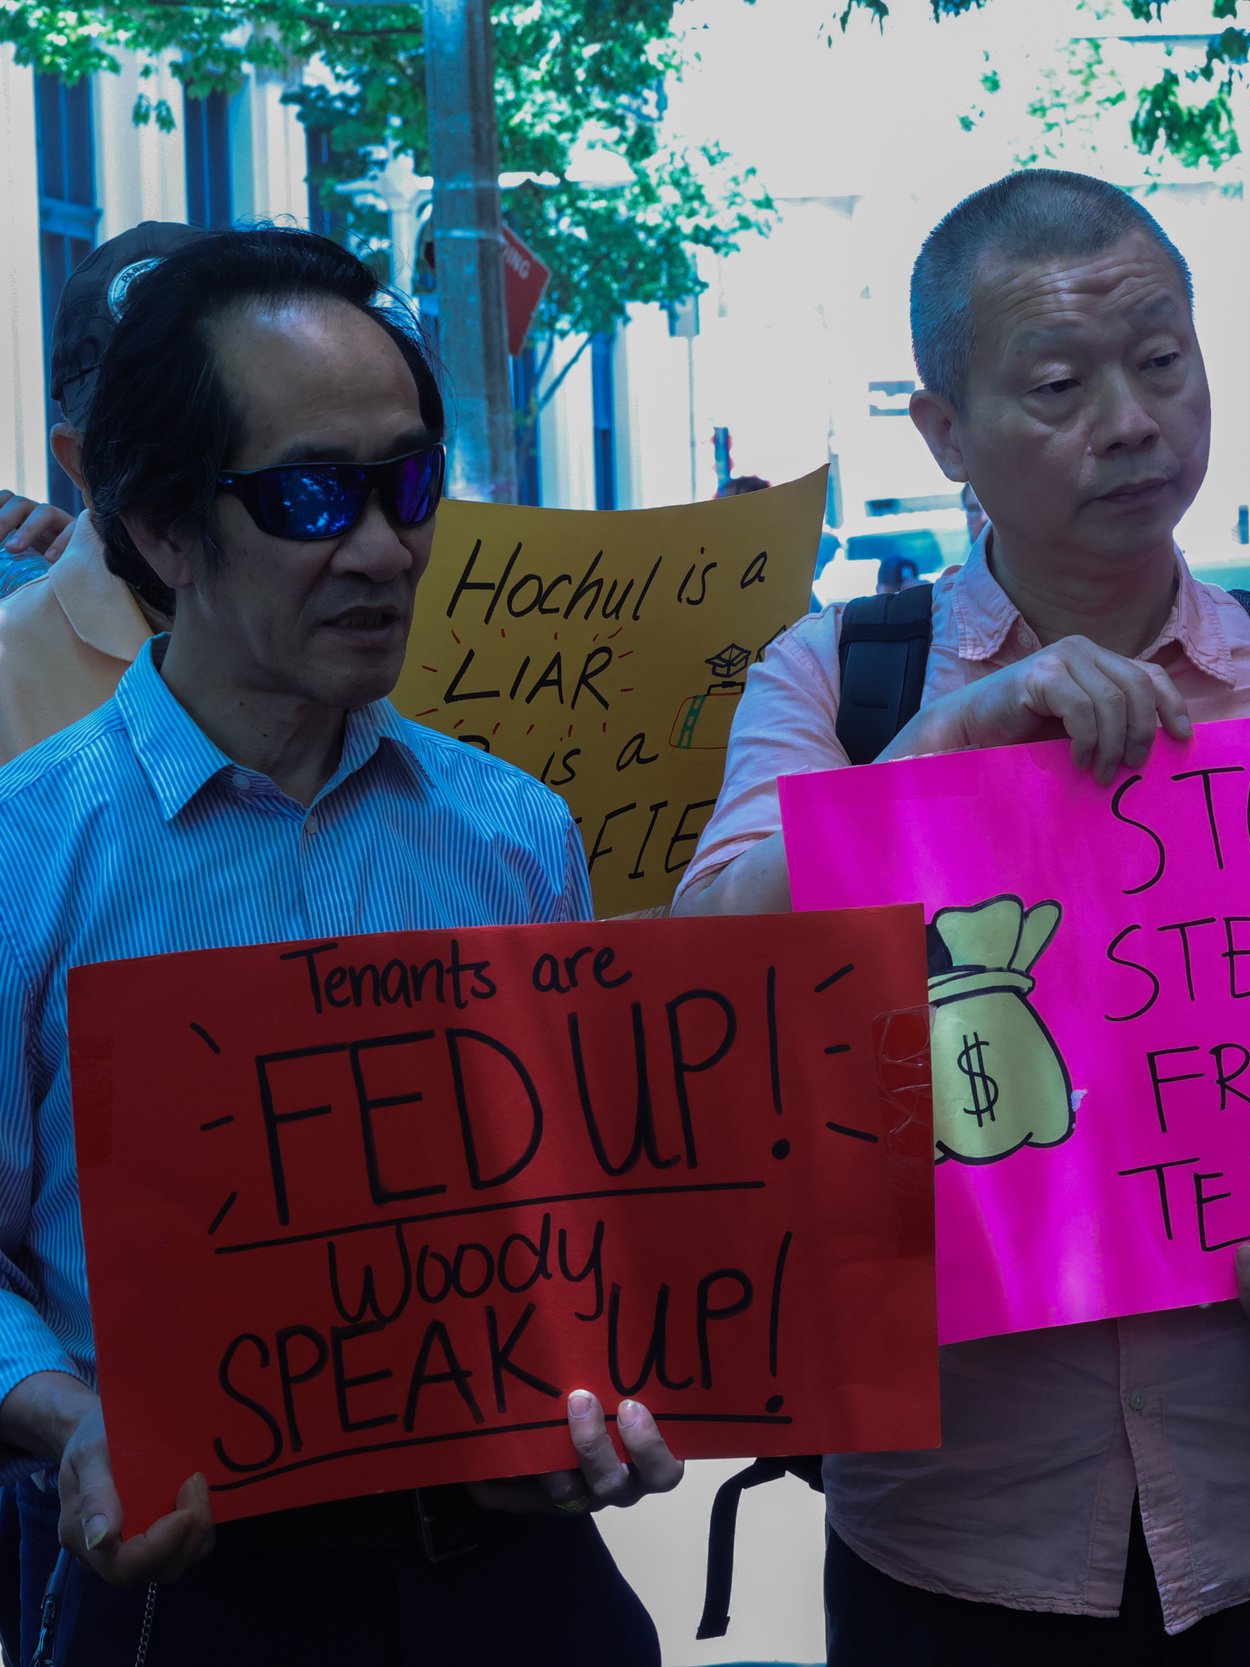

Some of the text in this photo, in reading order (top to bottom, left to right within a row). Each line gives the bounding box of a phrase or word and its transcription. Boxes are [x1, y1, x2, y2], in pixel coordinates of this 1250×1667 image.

[446, 539, 768, 625] Hochul is a
[443, 646, 613, 710] LIAR
[540, 736, 581, 786] is
[616, 732, 659, 772] a
[574, 798, 717, 880] FIE
[280, 940, 633, 1014] Tenants are
[255, 967, 792, 1225] FED UP!
[328, 1212, 606, 1324] Woody
[212, 1231, 793, 1475] SPEAK UP!
